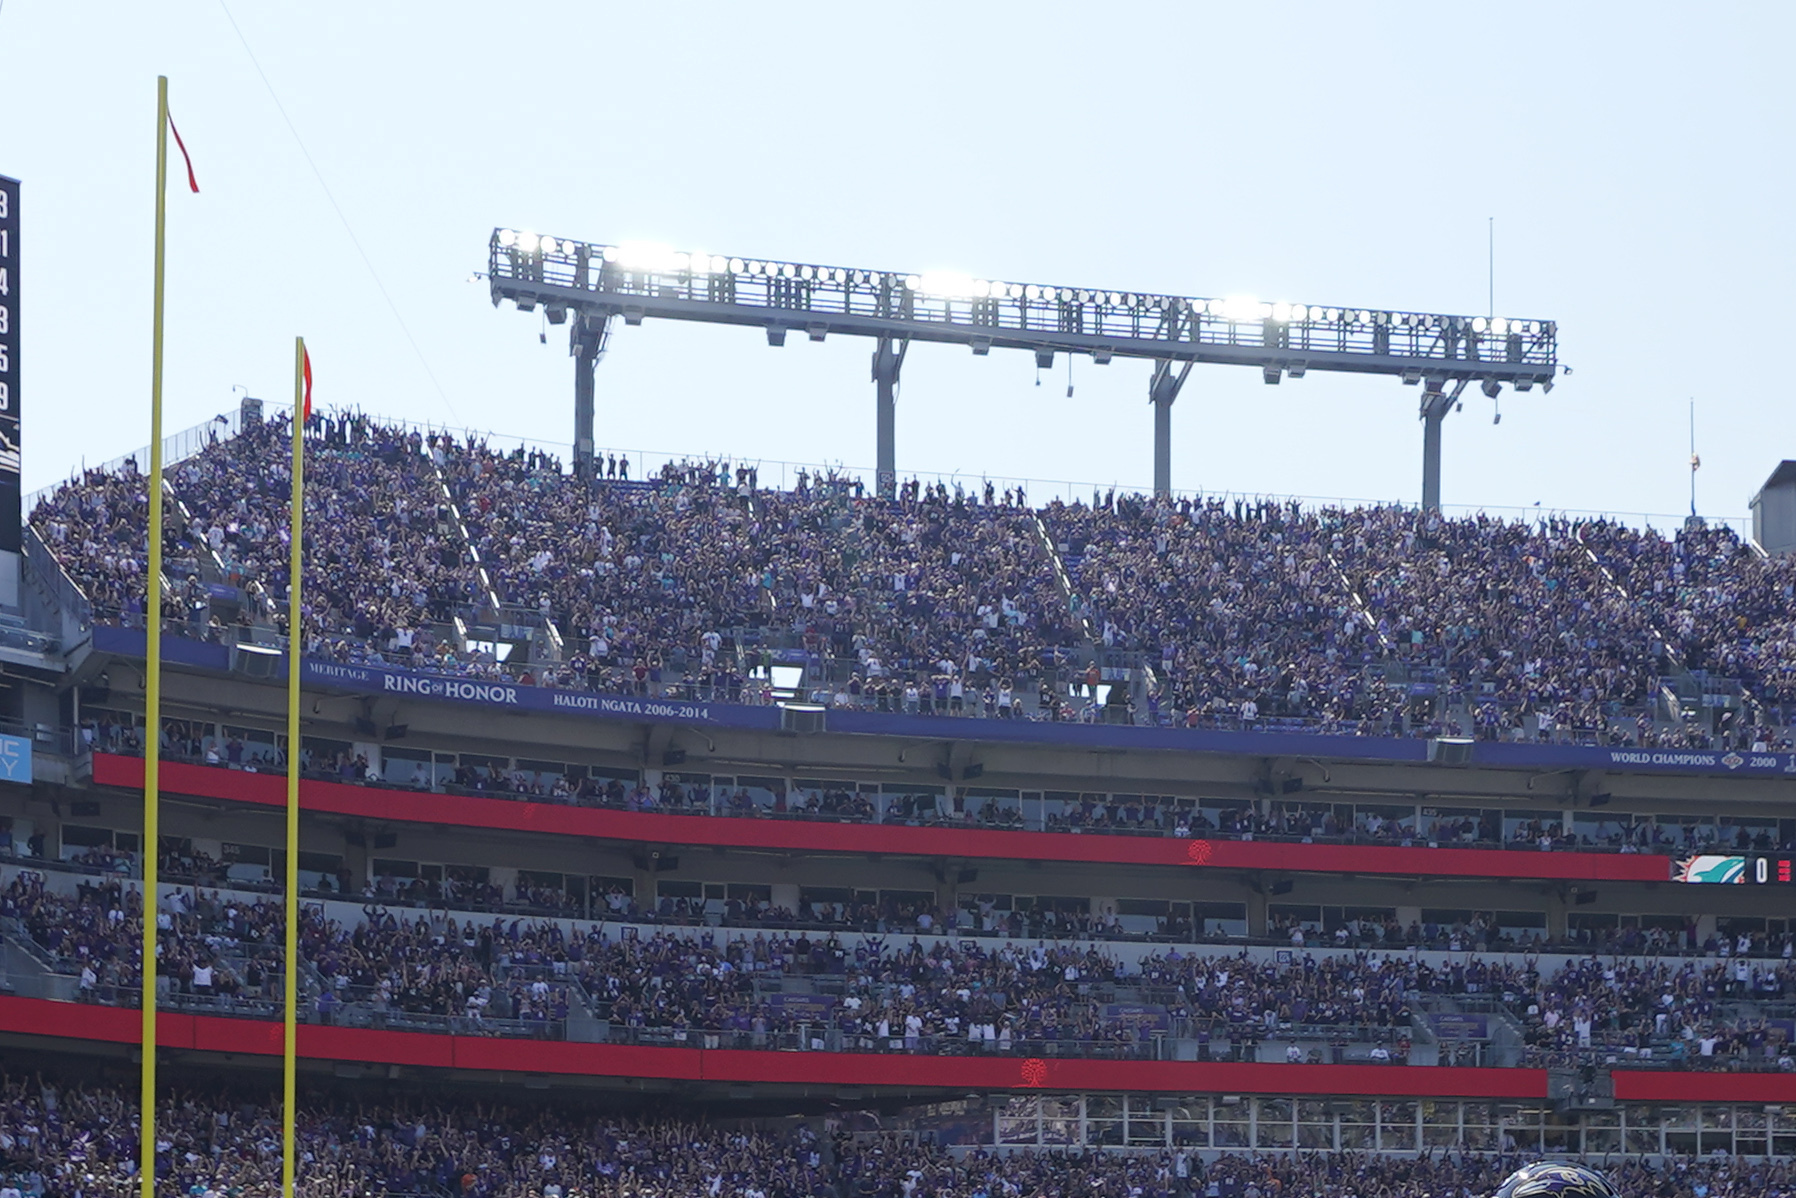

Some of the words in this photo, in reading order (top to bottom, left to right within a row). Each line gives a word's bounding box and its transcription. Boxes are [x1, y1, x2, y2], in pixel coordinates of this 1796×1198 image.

[309, 663, 369, 681] MERITAGE
[384, 675, 430, 695] RING
[432, 683, 443, 694] OF
[445, 682, 517, 704] HONOR
[554, 694, 597, 710] HALOTI
[601, 698, 641, 714] NGATA
[645, 704, 708, 719] 2006-2014
[1611, 752, 1650, 764] WORLD
[1652, 754, 1715, 766] CHAMPIONS
[1749, 757, 1776, 768] 2000
[1756, 857, 1768, 884] 0
